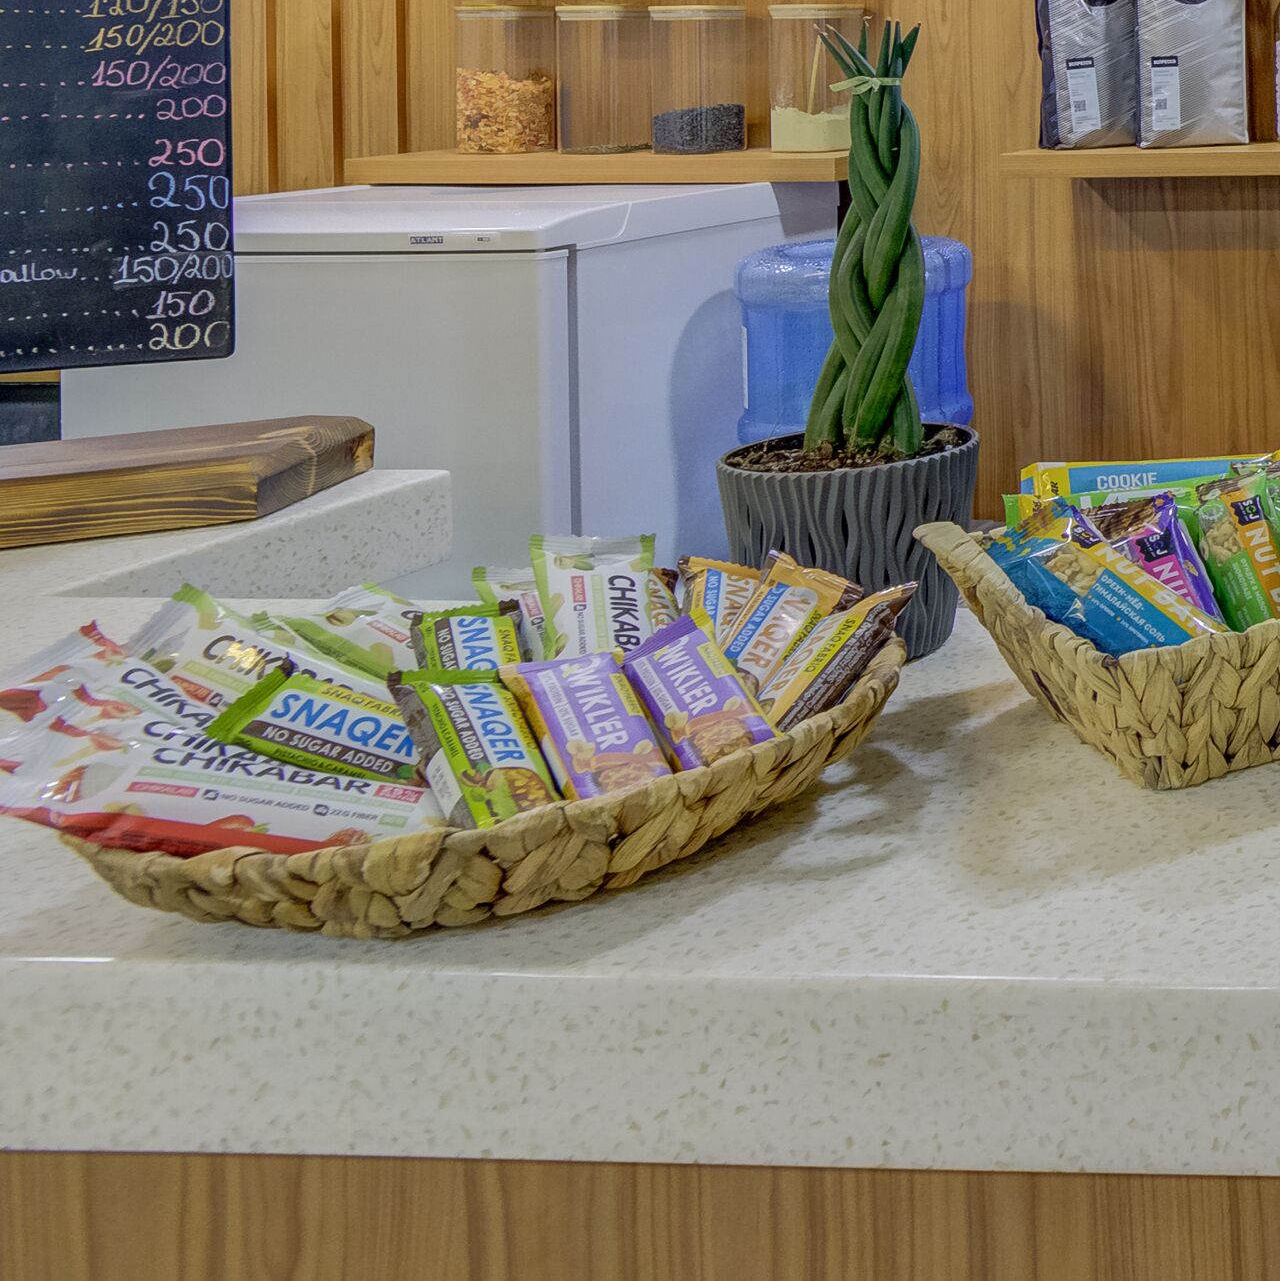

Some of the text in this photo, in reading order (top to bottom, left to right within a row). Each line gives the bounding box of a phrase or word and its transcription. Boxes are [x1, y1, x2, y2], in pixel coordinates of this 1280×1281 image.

[84, 20, 225, 56] 150/200
[91, 55, 227, 90] 150/200
[156, 95, 227, 121] 200
[148, 138, 227, 167] 250
[148, 172, 229, 211] 250
[150, 220, 229, 252] 250
[113, 253, 233, 285] 150/200
[145, 290, 216, 319] 150
[149, 321, 230, 350] 200
[1096, 471, 1158, 491] COOKIE
[708, 575, 719, 585] NO
[1095, 546, 1150, 586] NUT
[608, 574, 642, 652] CHIKAB
[750, 593, 775, 624] SUGAR
[1092, 583, 1166, 643] ГИМАЛАЙСКАЯ СОЛЬ
[437, 628, 451, 643] NO
[730, 623, 756, 653] ADDED
[804, 618, 857, 673] SNAQ FABRIQ
[121, 667, 216, 730] CHIKA
[320, 686, 364, 707] SNAQ
[560, 655, 629, 752] QWIKLER
[446, 699, 469, 731] SUGAR
[460, 730, 485, 760] ADDED
[261, 725, 394, 773] NO SUGAR ADDED
[152, 747, 373, 795] CHIKABAR
[219, 793, 310, 811] NO SUGAR ADDED
[350, 811, 379, 821] FIBER
